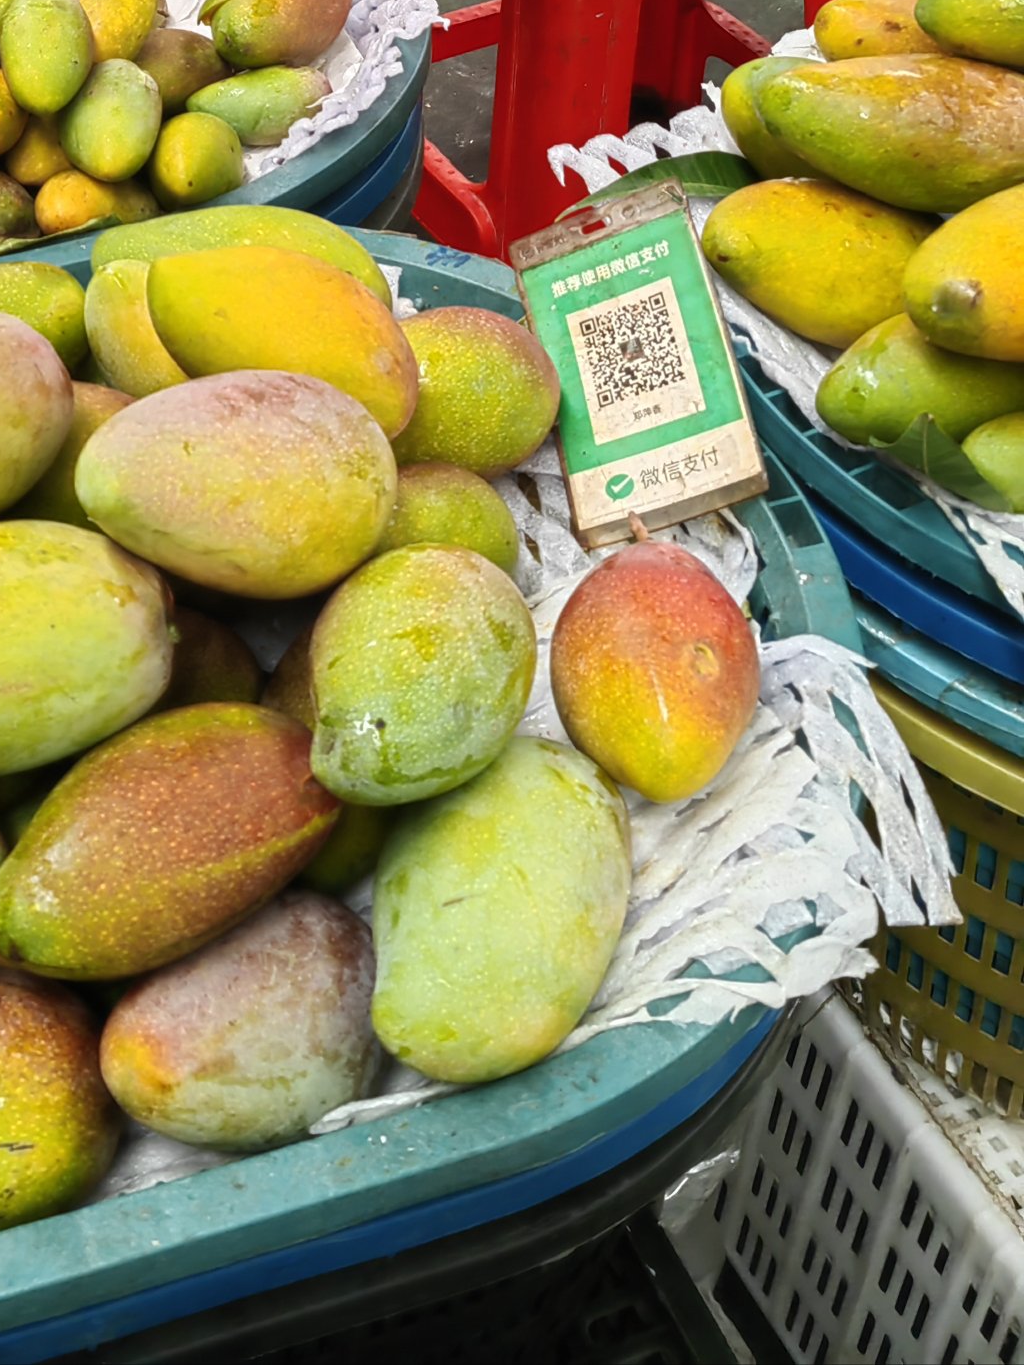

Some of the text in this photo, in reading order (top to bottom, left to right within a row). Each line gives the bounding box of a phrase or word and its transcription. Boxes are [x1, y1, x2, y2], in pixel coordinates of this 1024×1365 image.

[551, 239, 670, 298] 推荐使用微信支付
[639, 445, 719, 490] 微信支付
